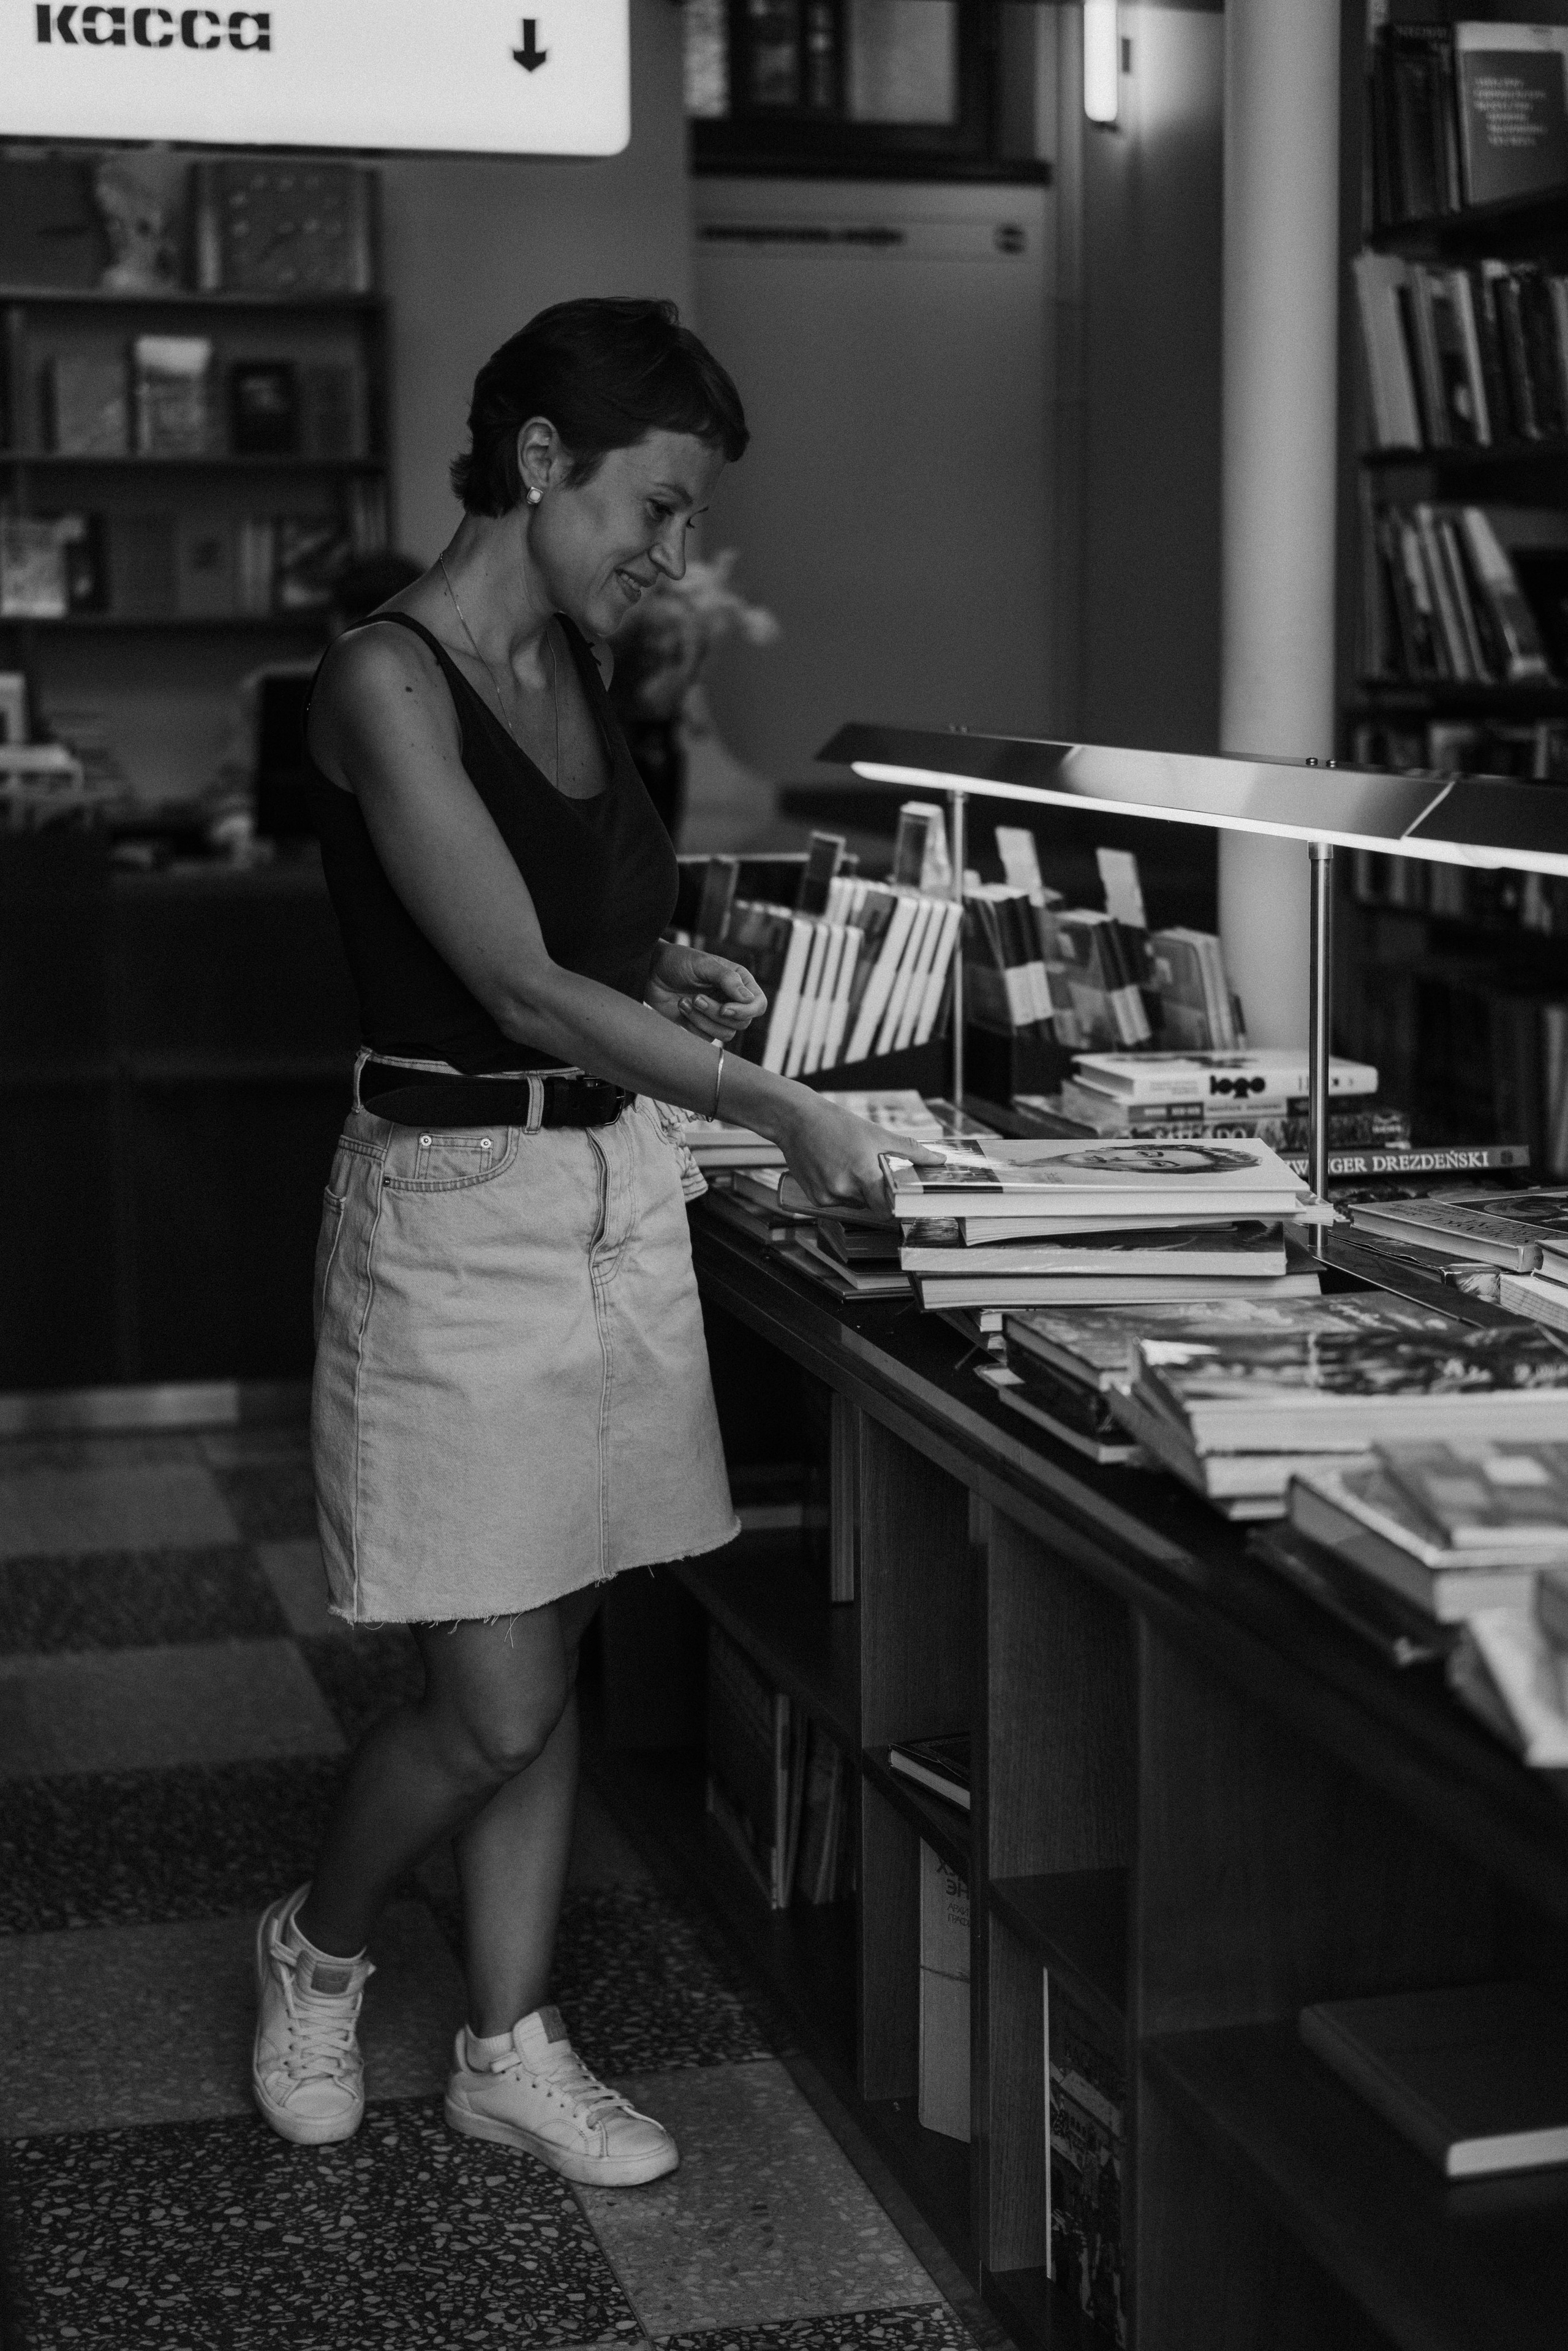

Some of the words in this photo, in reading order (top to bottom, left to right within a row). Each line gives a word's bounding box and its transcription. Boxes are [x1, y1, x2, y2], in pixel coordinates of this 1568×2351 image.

[36, 4, 271, 51] касса
[1372, 1150, 1489, 1172] DREZDEŃSKI
[947, 1903, 970, 1917] АРХИ
